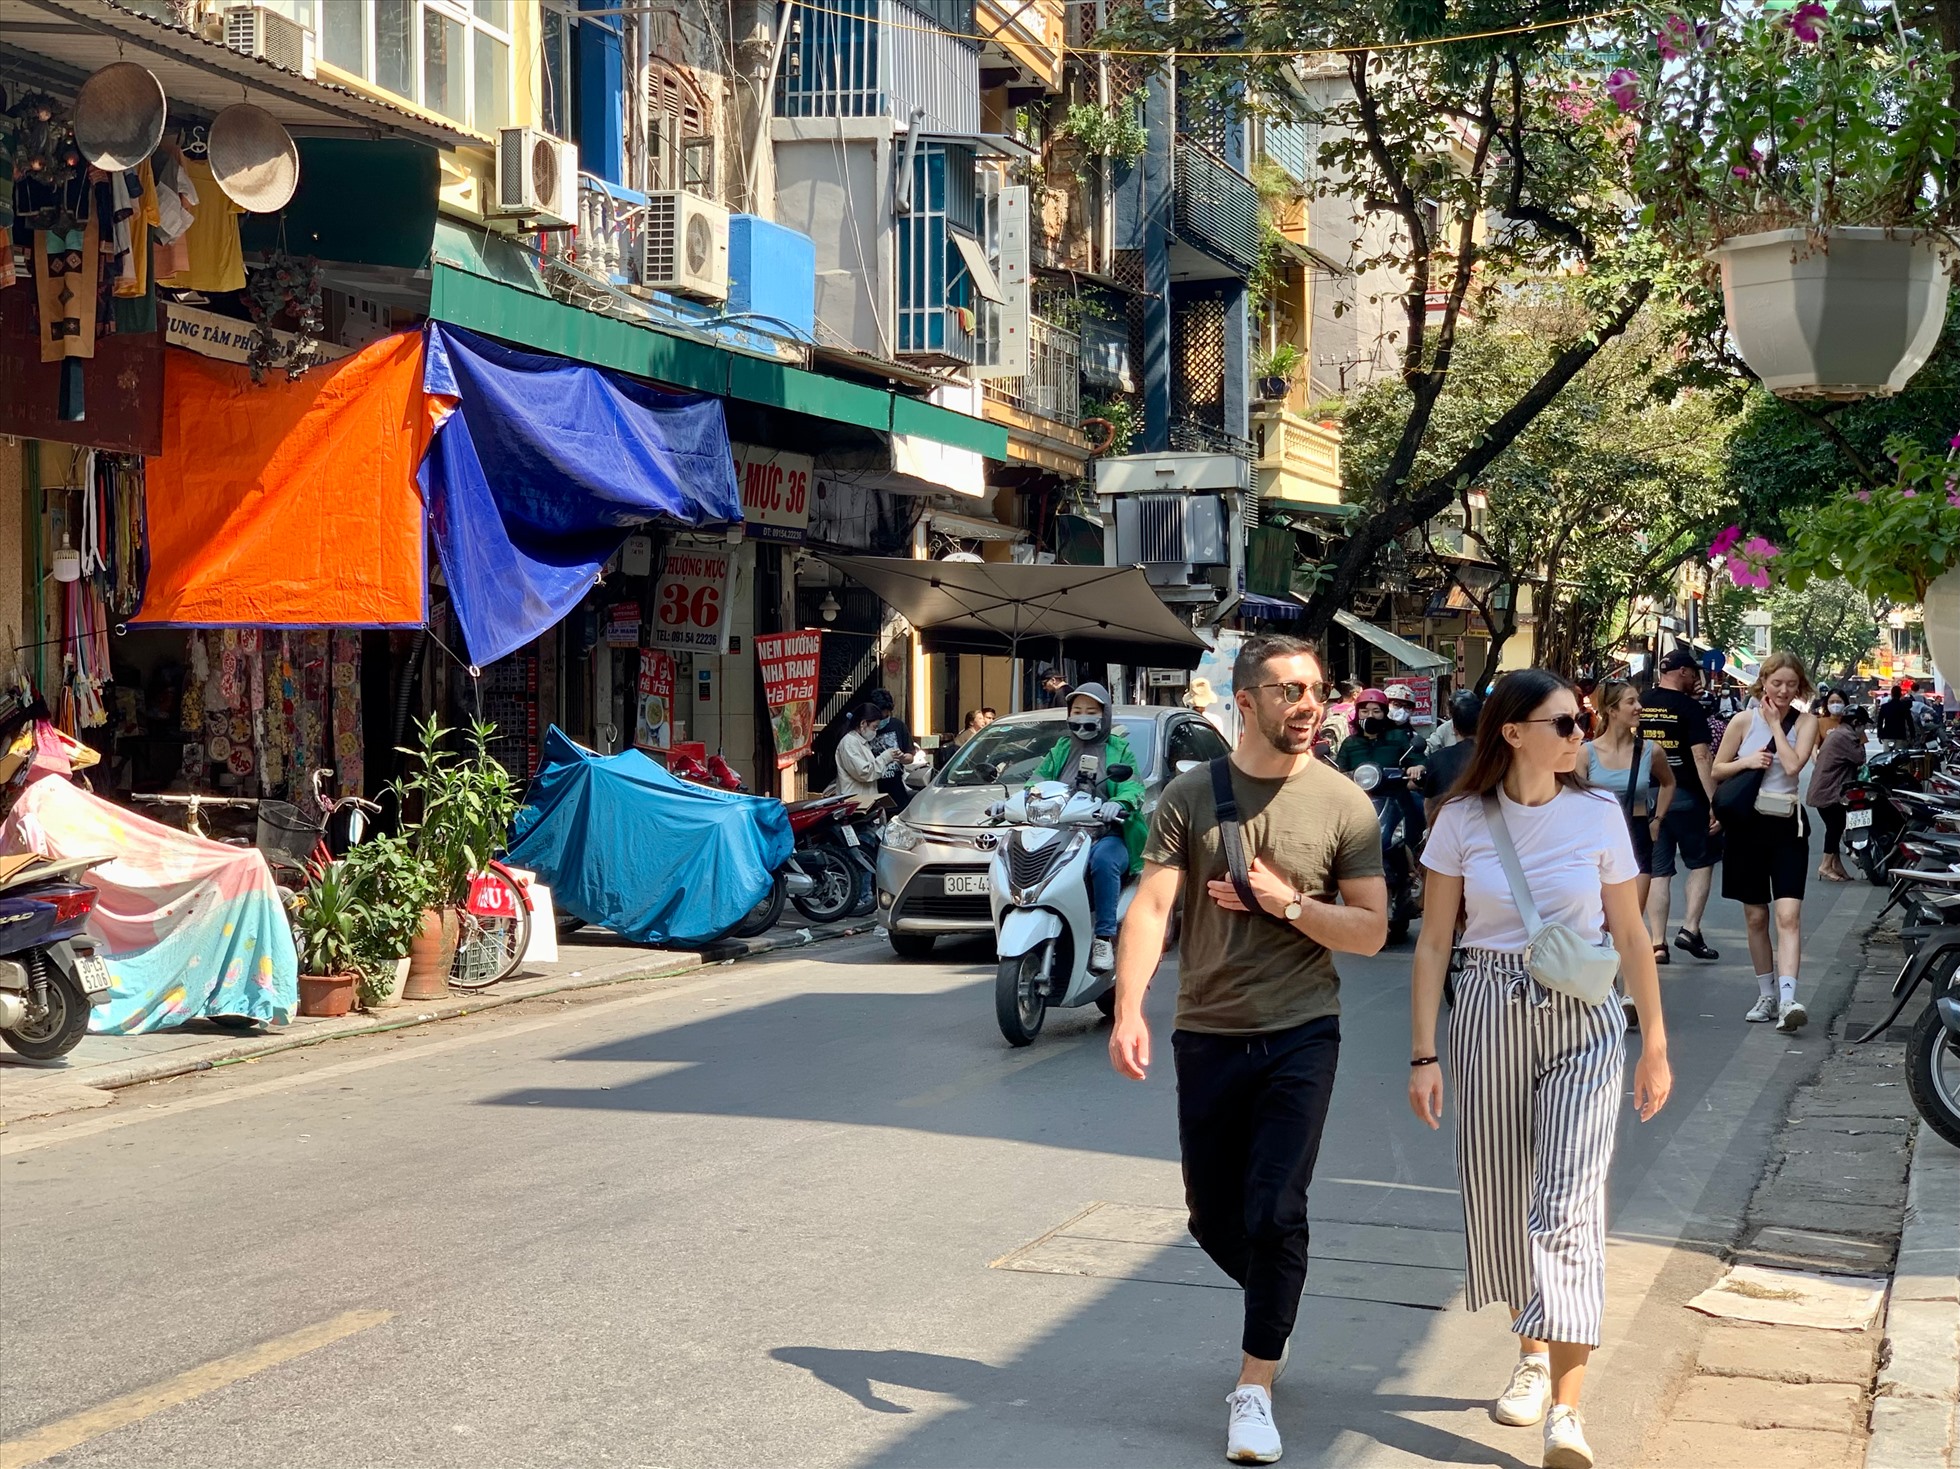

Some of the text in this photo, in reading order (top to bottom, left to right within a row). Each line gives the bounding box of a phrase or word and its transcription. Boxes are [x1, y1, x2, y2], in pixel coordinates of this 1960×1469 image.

[202, 325, 232, 346] TÂM
[743, 461, 783, 519] MỰC
[786, 470, 807, 514] 36
[704, 557, 726, 583] MỰC
[660, 583, 719, 628] 36
[656, 629, 670, 641] TEL:
[671, 631, 684, 642] 091
[686, 632, 694, 643] 54
[695, 633, 718, 646] 22236
[758, 640, 782, 660] NEM
[784, 634, 820, 657] NƯỚNG
[762, 659, 816, 684] NHA TRANG
[766, 680, 814, 704] Hà Thảo
[85, 972, 108, 990] 5206
